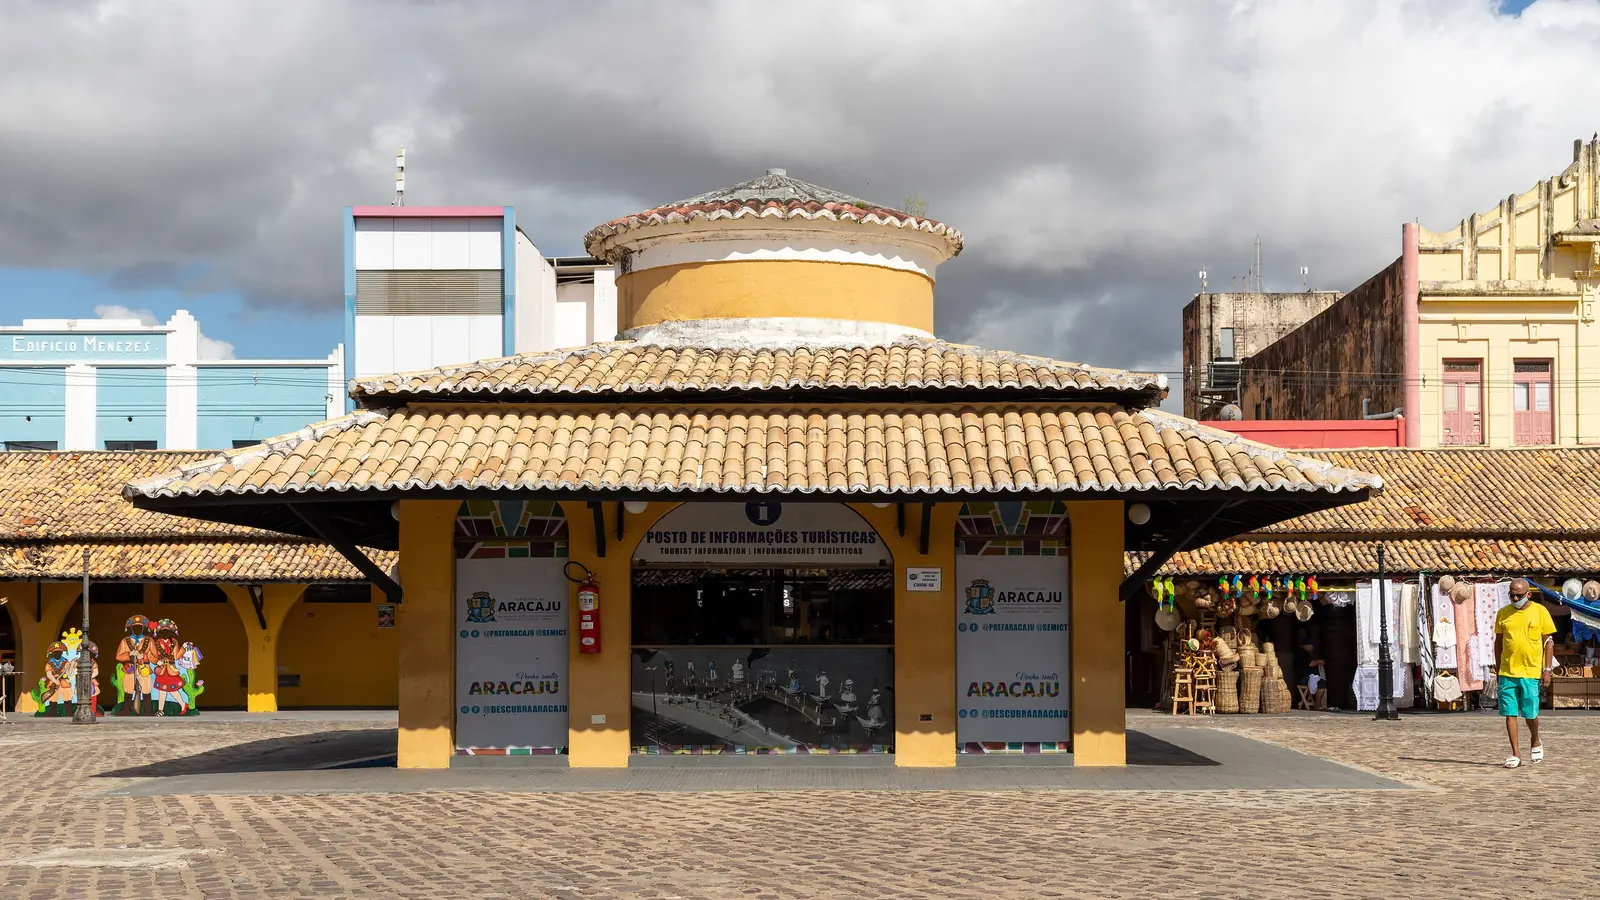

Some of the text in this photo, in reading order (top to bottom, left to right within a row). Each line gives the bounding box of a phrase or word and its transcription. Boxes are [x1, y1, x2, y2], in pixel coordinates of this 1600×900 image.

[646, 529, 876, 546] POSTO DE INFORMAÇÕES TURÍSTICAS
[660, 546, 863, 555] TOURIST INFORMATION INFORMACIONES TURÍSTICAS
[997, 592, 1062, 602] ARACAJU
[498, 602, 561, 611] ARACAJU
[982, 623, 1068, 631] @PREFARACAJU @SEMICT
[483, 629, 567, 637] @PREFARACAJU @SEMICT
[469, 681, 559, 695] ARACAJU
[967, 682, 1060, 697] ARACAJU
[483, 705, 568, 714] @DESCUBRAARACAJU
[981, 709, 1069, 719] @DESCUBRAARACAJU
